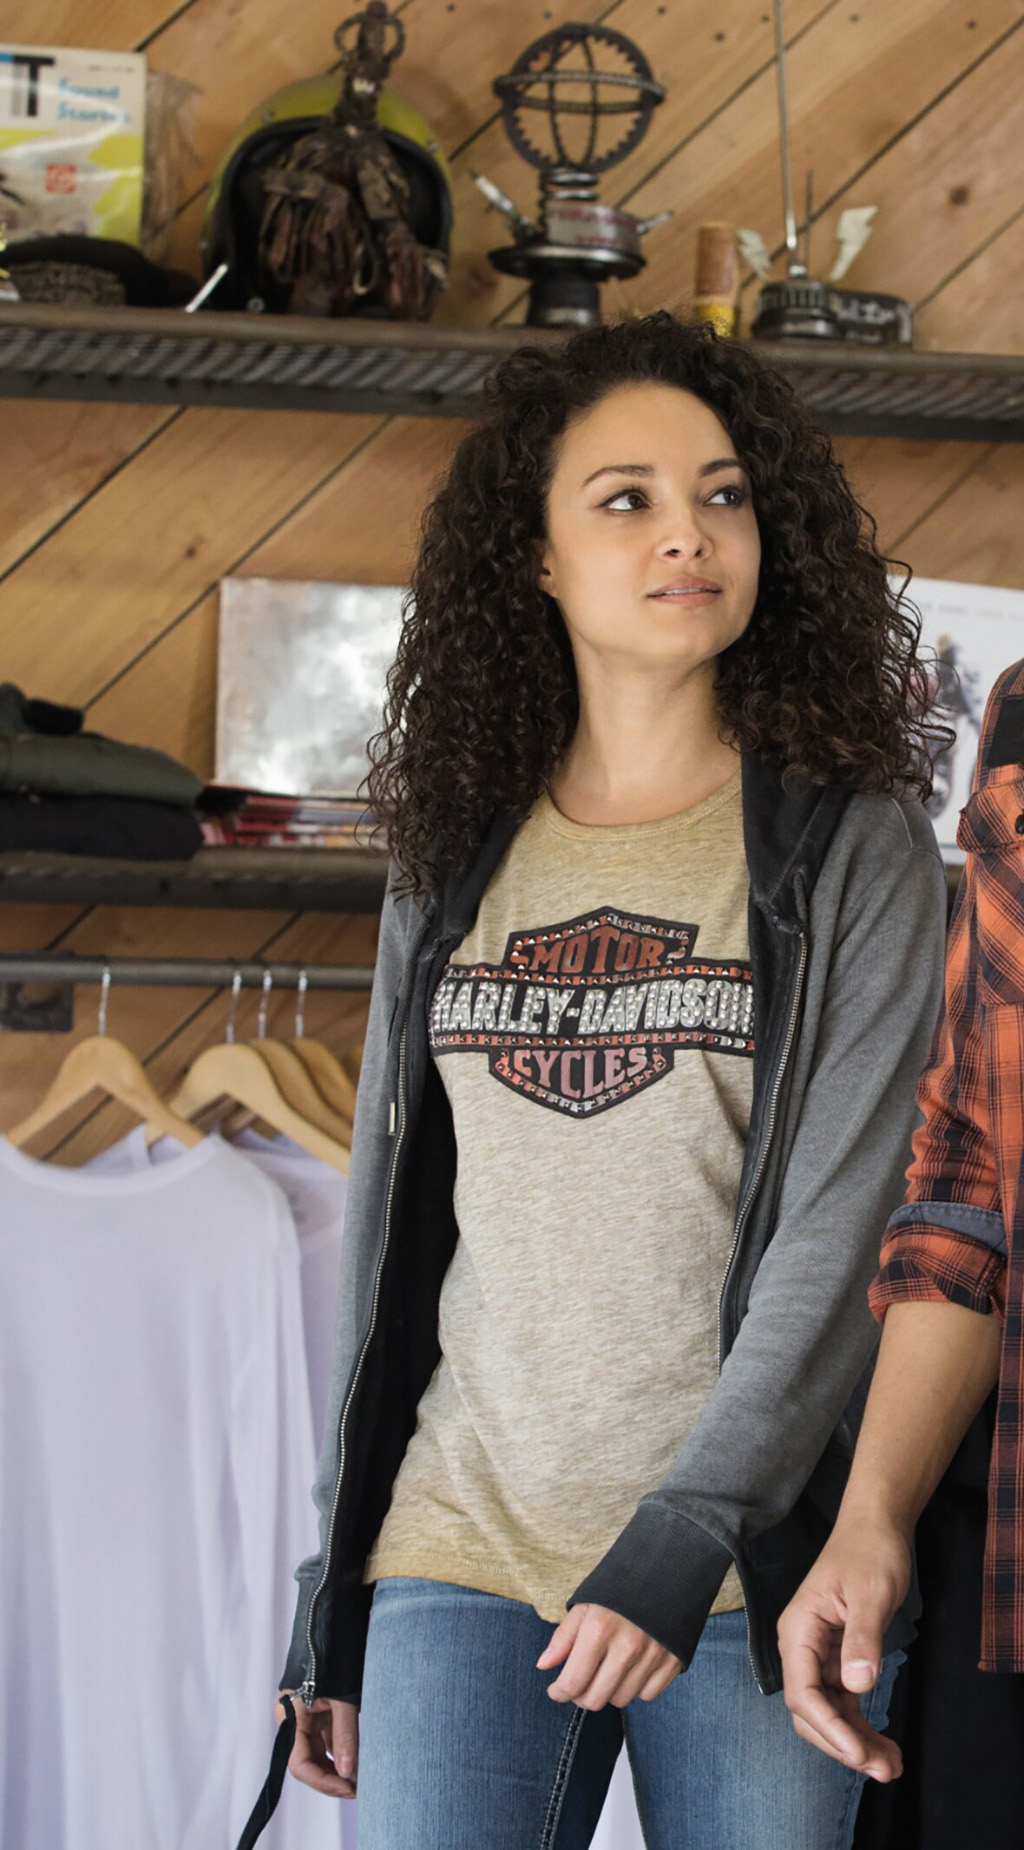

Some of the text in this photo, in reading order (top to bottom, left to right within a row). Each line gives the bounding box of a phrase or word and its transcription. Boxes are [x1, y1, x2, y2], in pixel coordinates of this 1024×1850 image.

[528, 924, 666, 975] MOTOR
[432, 977, 754, 1036] HARLEY-DAVIDSON
[511, 1046, 649, 1099] CYCLES
